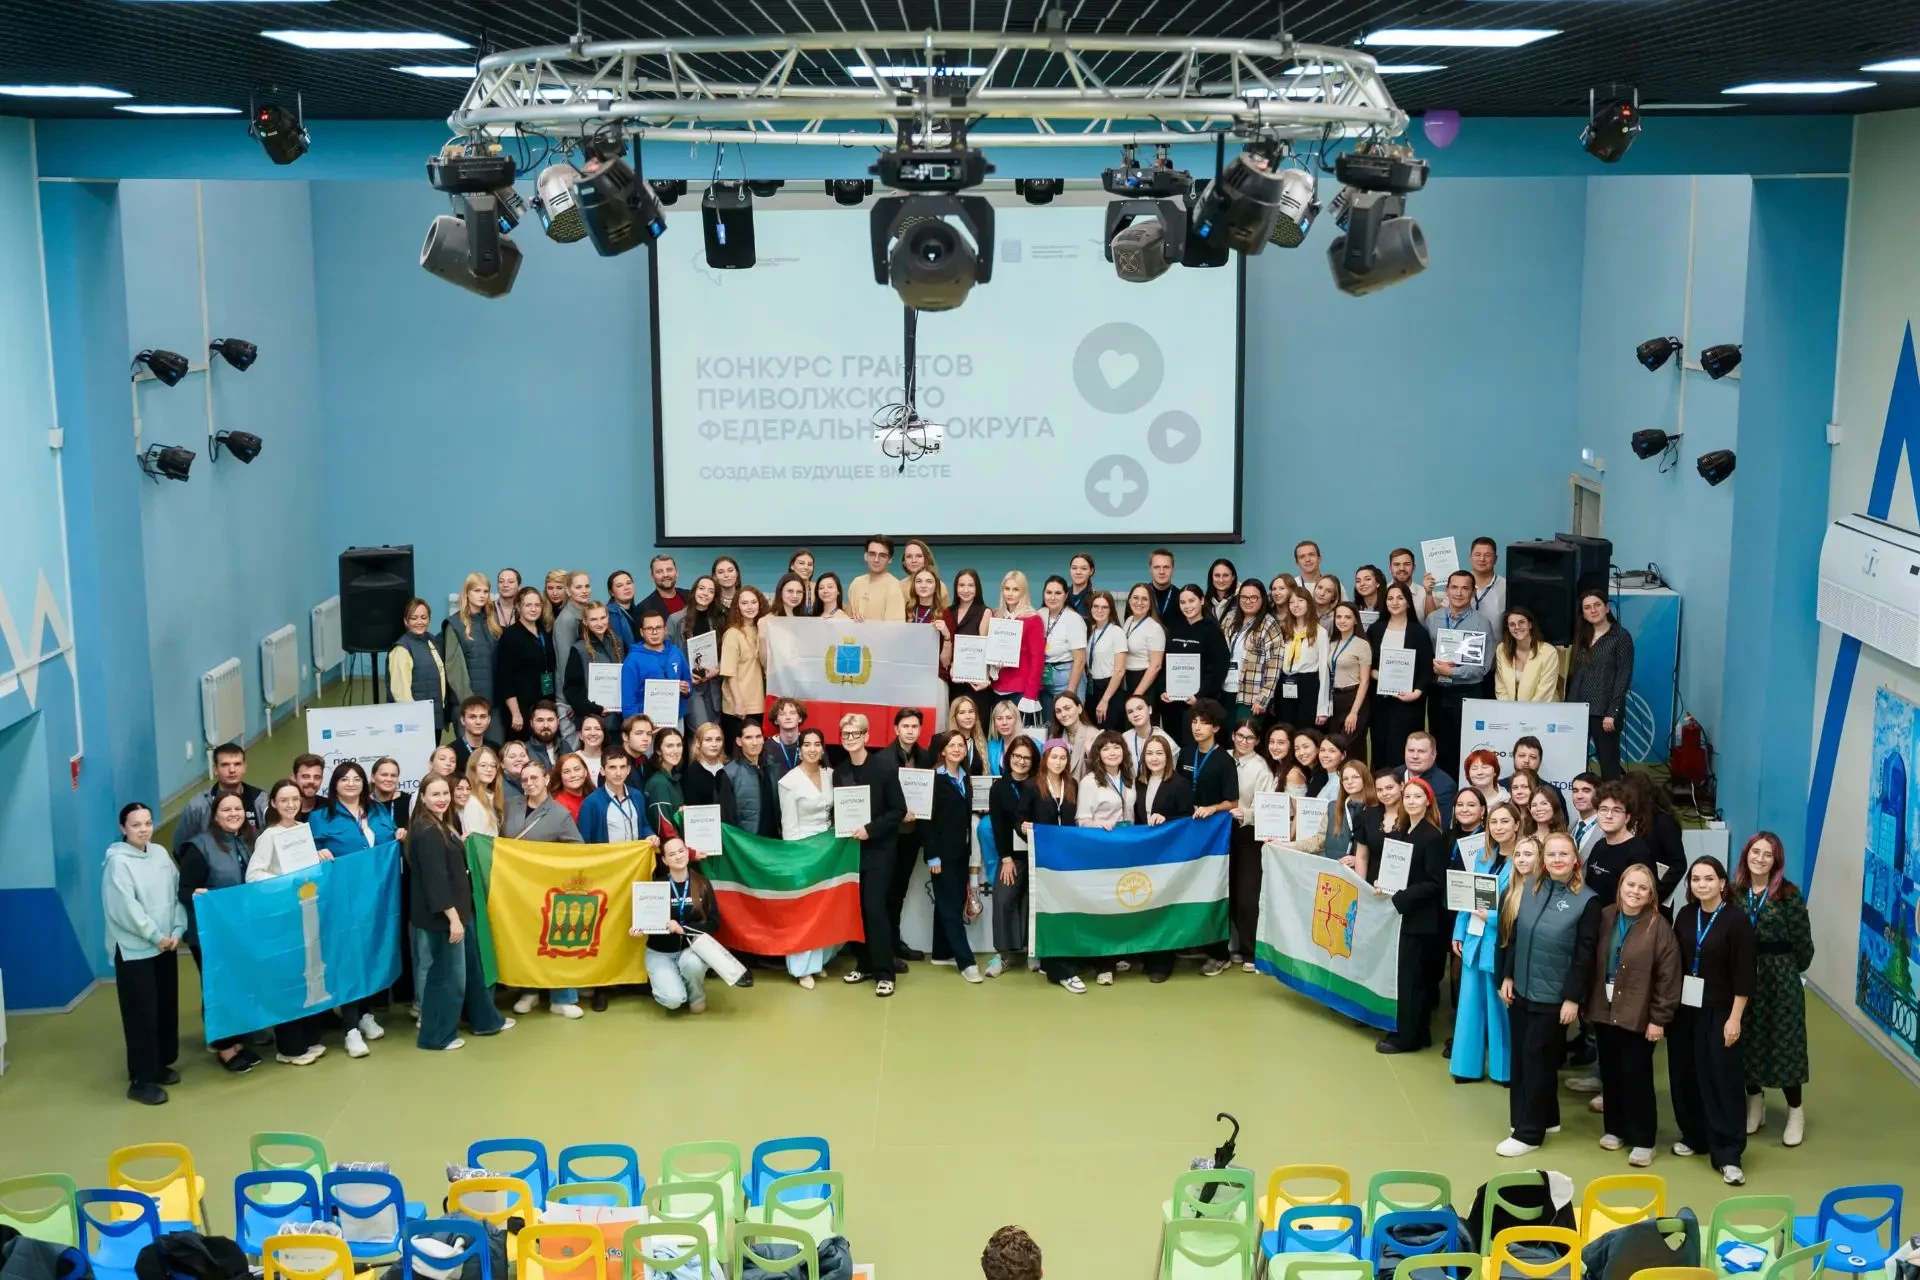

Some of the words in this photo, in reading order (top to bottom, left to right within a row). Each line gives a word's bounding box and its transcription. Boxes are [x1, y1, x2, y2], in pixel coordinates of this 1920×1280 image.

[696, 355, 833, 379] КОНКУРС
[697, 386, 945, 410] ПРИВОЛЖСКОО
[697, 418, 937, 444] ФЕДЕРАЛЬН
[946, 416, 1055, 440] ОКРУГА
[699, 465, 786, 482] СОЗДАЕМ
[792, 464, 875, 481] БУДУЩЕЕ
